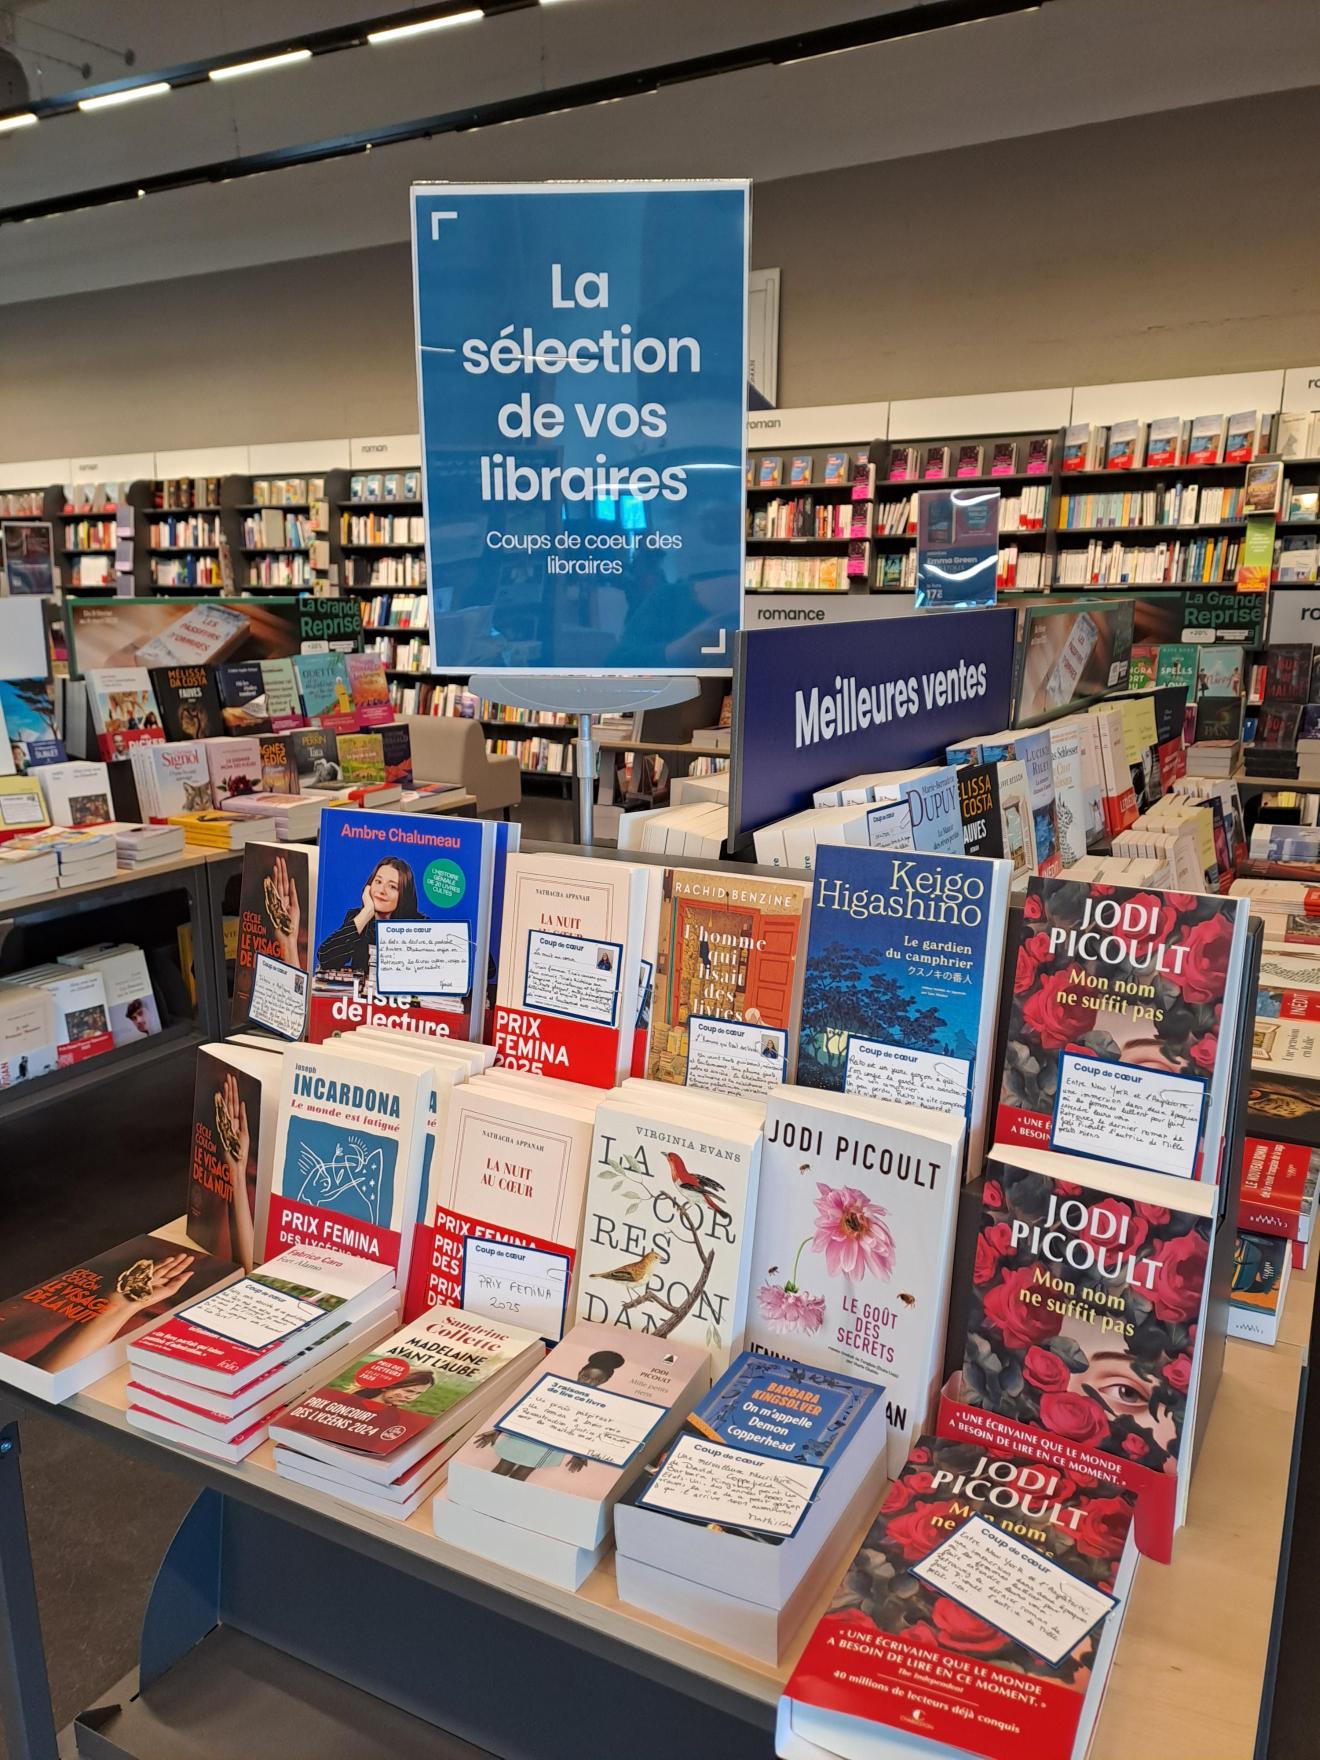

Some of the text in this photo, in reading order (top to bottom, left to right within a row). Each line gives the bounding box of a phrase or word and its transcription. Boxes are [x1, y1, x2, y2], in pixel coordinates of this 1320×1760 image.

[552, 264, 609, 308] La
[462, 324, 701, 374] sélection
[498, 393, 668, 438] de vos
[481, 454, 688, 501] libraires
[486, 531, 551, 554] Coups
[555, 531, 580, 549] de
[646, 531, 682, 549] des
[547, 555, 623, 574] libraires
[317, 600, 360, 615] Grande
[757, 606, 825, 622] romance
[1185, 592, 1263, 610] La Grande
[301, 615, 361, 638] Reprise
[1185, 608, 1262, 626] Reprise
[168, 668, 206, 678] MÉLISSA
[170, 676, 207, 688] DA COSTA
[1161, 667, 1192, 675] SPELLS
[179, 688, 202, 697] FAUVES
[795, 676, 919, 749] Meilleures
[923, 658, 988, 711] ventes
[162, 750, 199, 769] Signol
[906, 785, 956, 828] DUPUY
[963, 793, 993, 818] COSTA
[341, 823, 461, 848] Ambre Chalumeau
[432, 886, 452, 897] CULTES
[675, 882, 791, 907] RACHID BENZINE
[890, 860, 984, 902] Keigo
[816, 878, 982, 927] Higashino
[541, 913, 581, 930] LA NUIT
[1080, 898, 1160, 935] JODI
[708, 949, 737, 965] qui
[904, 935, 972, 955] Le gardien
[1048, 927, 1190, 975] PICOULT
[885, 948, 973, 970] du camphrier
[699, 962, 744, 986] lisait
[907, 966, 972, 985] クスノキの番人
[1069, 968, 1155, 998] Mon nom
[704, 983, 735, 1003] des
[1287, 993, 1308, 1016] INÉDIT
[332, 996, 363, 1021] de
[367, 1004, 450, 1038] lecture
[1056, 991, 1164, 1023] ne suffit pas
[496, 1011, 542, 1038] PRIX
[495, 1032, 569, 1066] FEMINA
[293, 1073, 400, 1118] INCARDONA
[290, 1099, 400, 1132] Le monde est fatigué
[598, 1135, 654, 1178] LA
[636, 1126, 741, 1163] VIRGINIA EVANS
[768, 1118, 941, 1190] JODI PICOULT
[486, 1158, 532, 1180] LA NUIT
[1245, 1145, 1268, 1189] LE NOUVEAU ROMAN
[481, 1174, 533, 1198] AU CŒUR
[437, 1212, 471, 1236] PRIX
[652, 1191, 737, 1244] COR
[1044, 1194, 1130, 1245] JODI
[281, 1209, 380, 1257] PRIX FEMINA
[590, 1213, 671, 1265] RES
[277, 1256, 322, 1271] Fort Alamo
[288, 1249, 344, 1268] Fabrice Caro
[432, 1251, 459, 1275] DES
[1010, 1219, 1163, 1290] PICOULT
[429, 1273, 461, 1299] PRIX
[479, 1275, 552, 1300] PRIX FEMINA
[1033, 1267, 1125, 1311] Mon nom
[489, 1297, 521, 1313] 2025
[842, 1295, 898, 1330] LE GOÛT
[1020, 1287, 1135, 1337] ne suffit pas
[426, 1323, 502, 1352] Collette
[444, 1316, 509, 1341] Sandrine
[855, 1316, 880, 1339] DES
[405, 1336, 488, 1366] MADELAINE
[837, 1326, 895, 1363] SECRETS
[217, 1359, 240, 1371] folio
[386, 1345, 432, 1367] AVANT
[430, 1358, 480, 1378] L'AUBE
[641, 1371, 671, 1384] PICOULT
[751, 1389, 822, 1416] KINGSOLVER
[767, 1383, 820, 1401] BARBARA
[291, 1407, 378, 1436] DES LYCÉENS 2024
[304, 1397, 378, 1422] PRIX GONCOURT
[742, 1401, 812, 1430] On m'appelle
[727, 1425, 796, 1452] Copperhead
[748, 1417, 788, 1436] Demon
[962, 1412, 1122, 1474] UNE ÉCRIVAINE QUE LE MONDE
[971, 1456, 1057, 1496] JODI
[930, 1471, 1088, 1530] PICOULT
[930, 1515, 956, 1530] ne
[827, 1637, 1039, 1706] A BESOIN DE LIRE EN CE MOMENT.
[847, 1629, 1042, 1695] UNE ÉCRIVAINE QUE LE MONDE
[833, 1669, 1021, 1733] 40 millions de lecteurs déjà conquis
